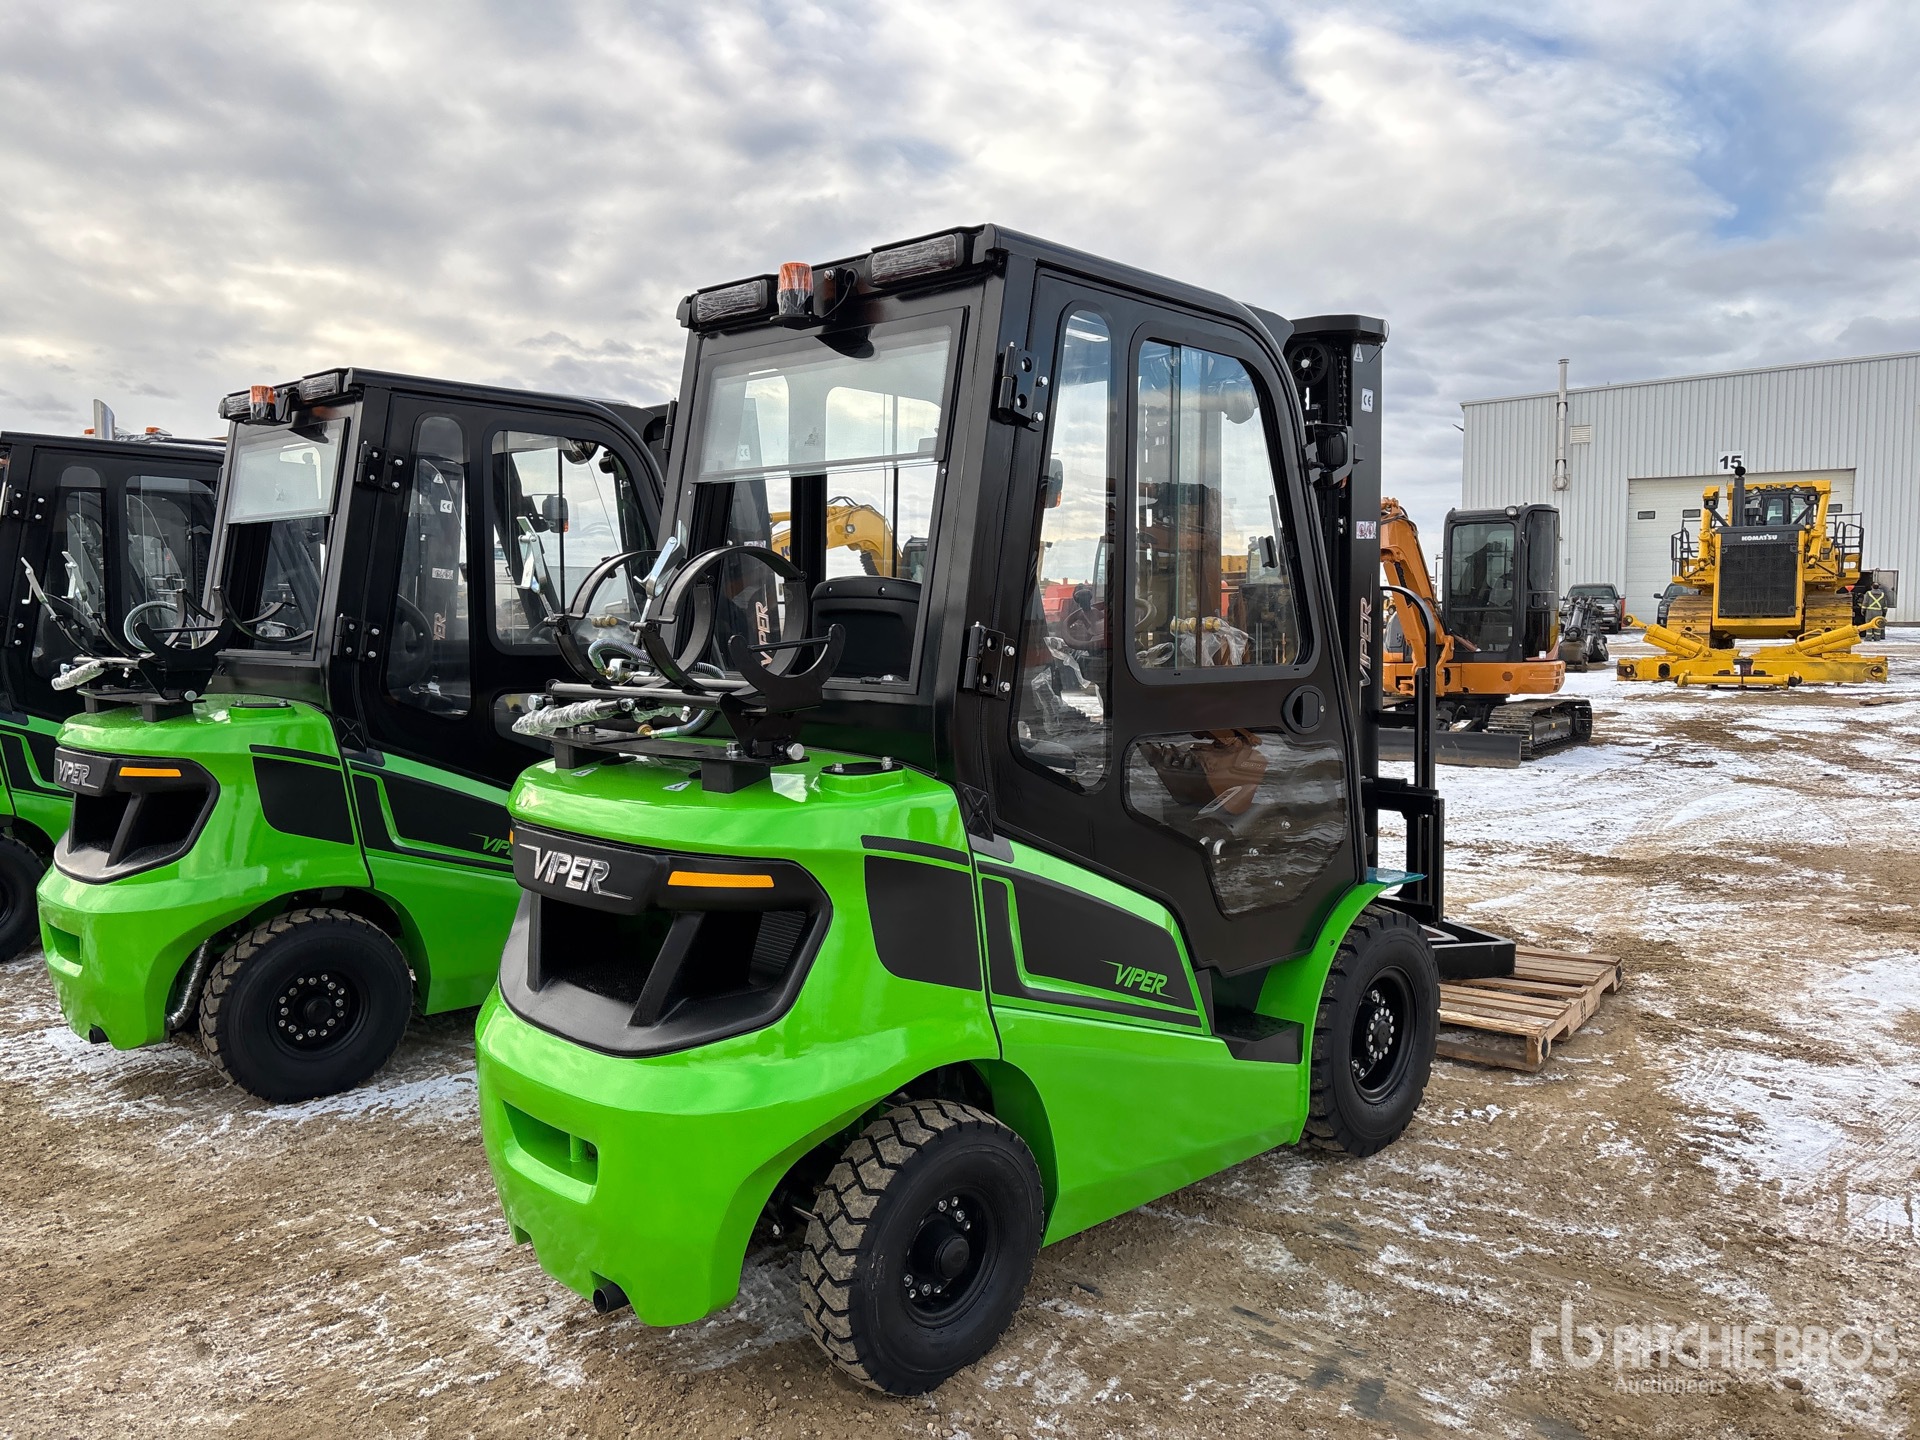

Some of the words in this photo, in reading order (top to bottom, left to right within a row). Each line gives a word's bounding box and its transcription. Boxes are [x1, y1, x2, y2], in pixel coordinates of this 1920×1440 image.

[1363, 394, 1372, 406] CE
[1720, 455, 1742, 470] 15
[1741, 533, 1778, 541] KOMATSU
[755, 583, 773, 666] VPER
[1359, 573, 1373, 716] VIPER
[56, 758, 99, 789] VIPER
[519, 843, 633, 901] VIPER
[1100, 959, 1179, 1000] VIPER
